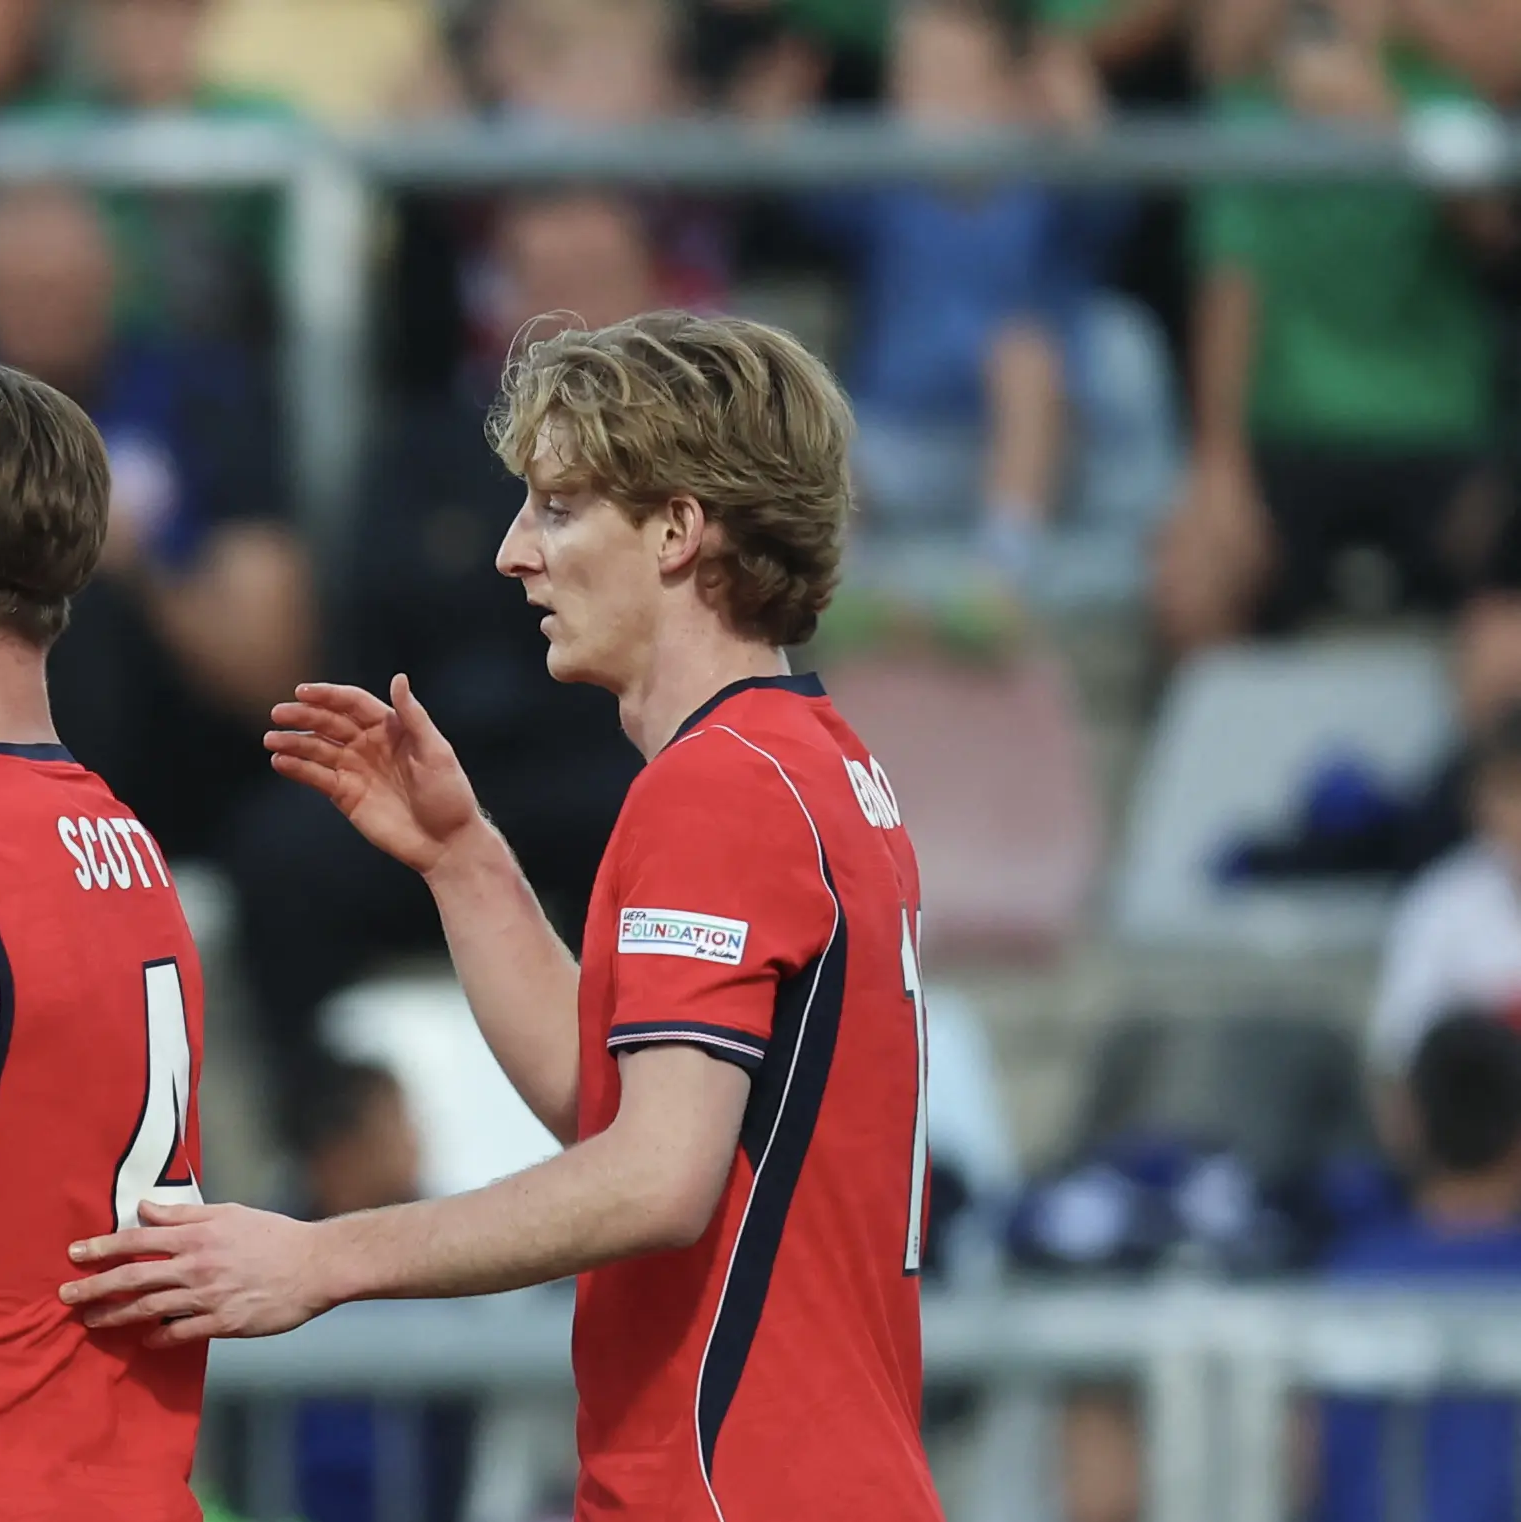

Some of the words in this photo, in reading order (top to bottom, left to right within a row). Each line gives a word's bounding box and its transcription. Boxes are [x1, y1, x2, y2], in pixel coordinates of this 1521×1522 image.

[57, 816, 170, 890] SCOTT
[623, 911, 647, 920] UEFA
[622, 923, 742, 949] FOUNDATION
